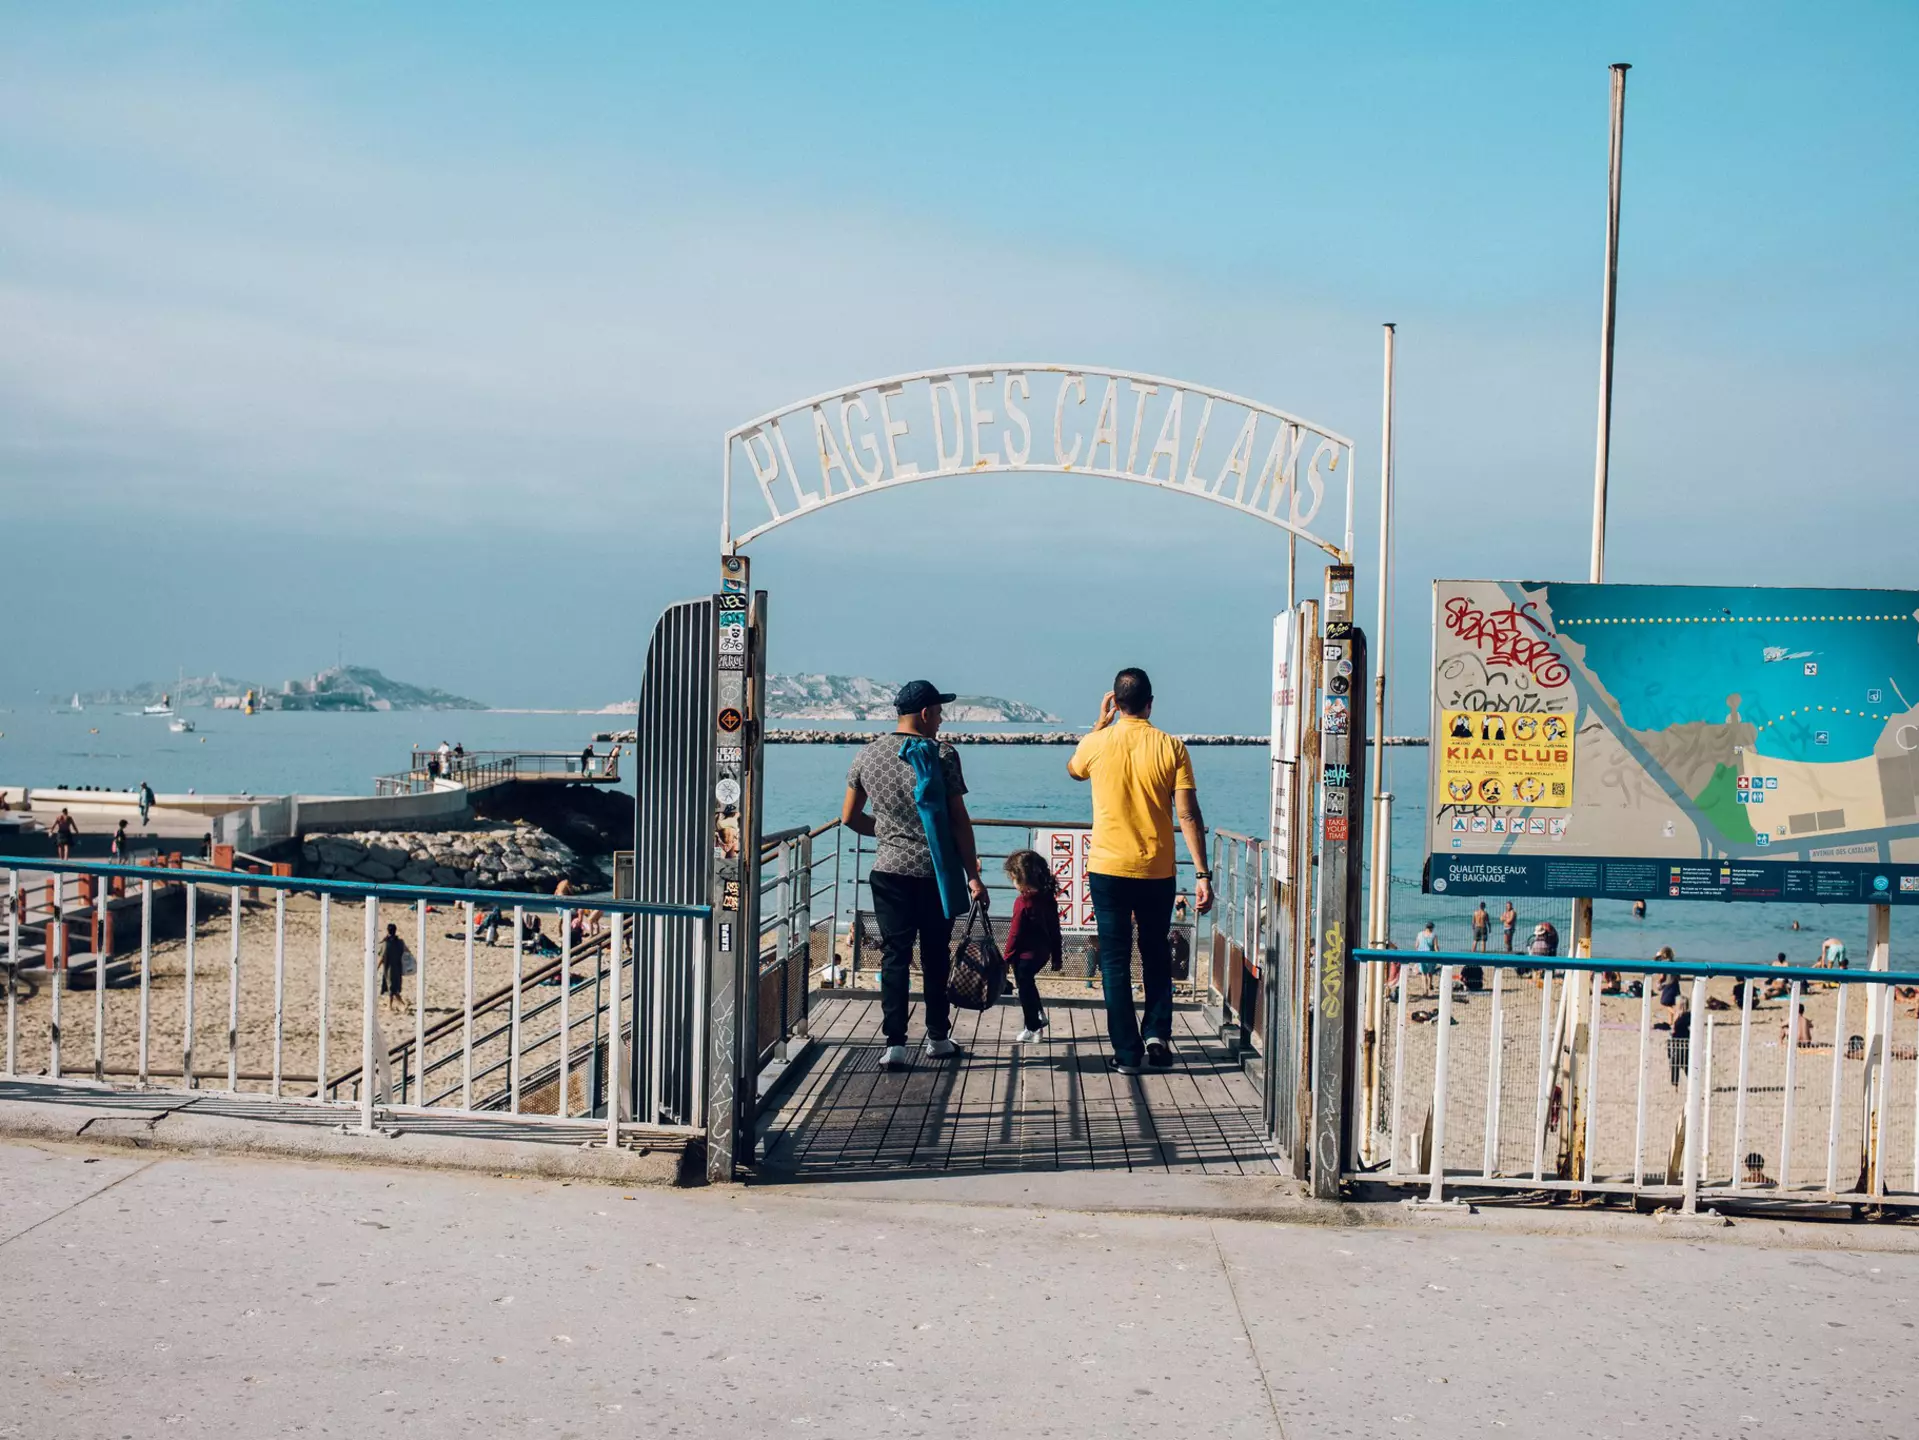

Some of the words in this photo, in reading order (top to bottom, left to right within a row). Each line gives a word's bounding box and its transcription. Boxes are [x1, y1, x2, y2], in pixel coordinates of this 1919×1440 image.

[741, 382, 920, 522] PLAGE
[929, 371, 1031, 471] DES
[1053, 373, 1340, 529] CATALANS
[1447, 747, 1494, 760] KIAI
[1504, 748, 1568, 763] CLUB
[1812, 850, 1834, 858] AVENUE
[1835, 848, 1847, 856] DES
[1847, 846, 1876, 855] CATALANS
[1449, 863, 1485, 874] QUALITÉ
[1487, 865, 1504, 874] DES
[1504, 866, 1527, 875] EAUX
[1449, 873, 1461, 882] DE
[1462, 873, 1506, 883] BAIGNADE
